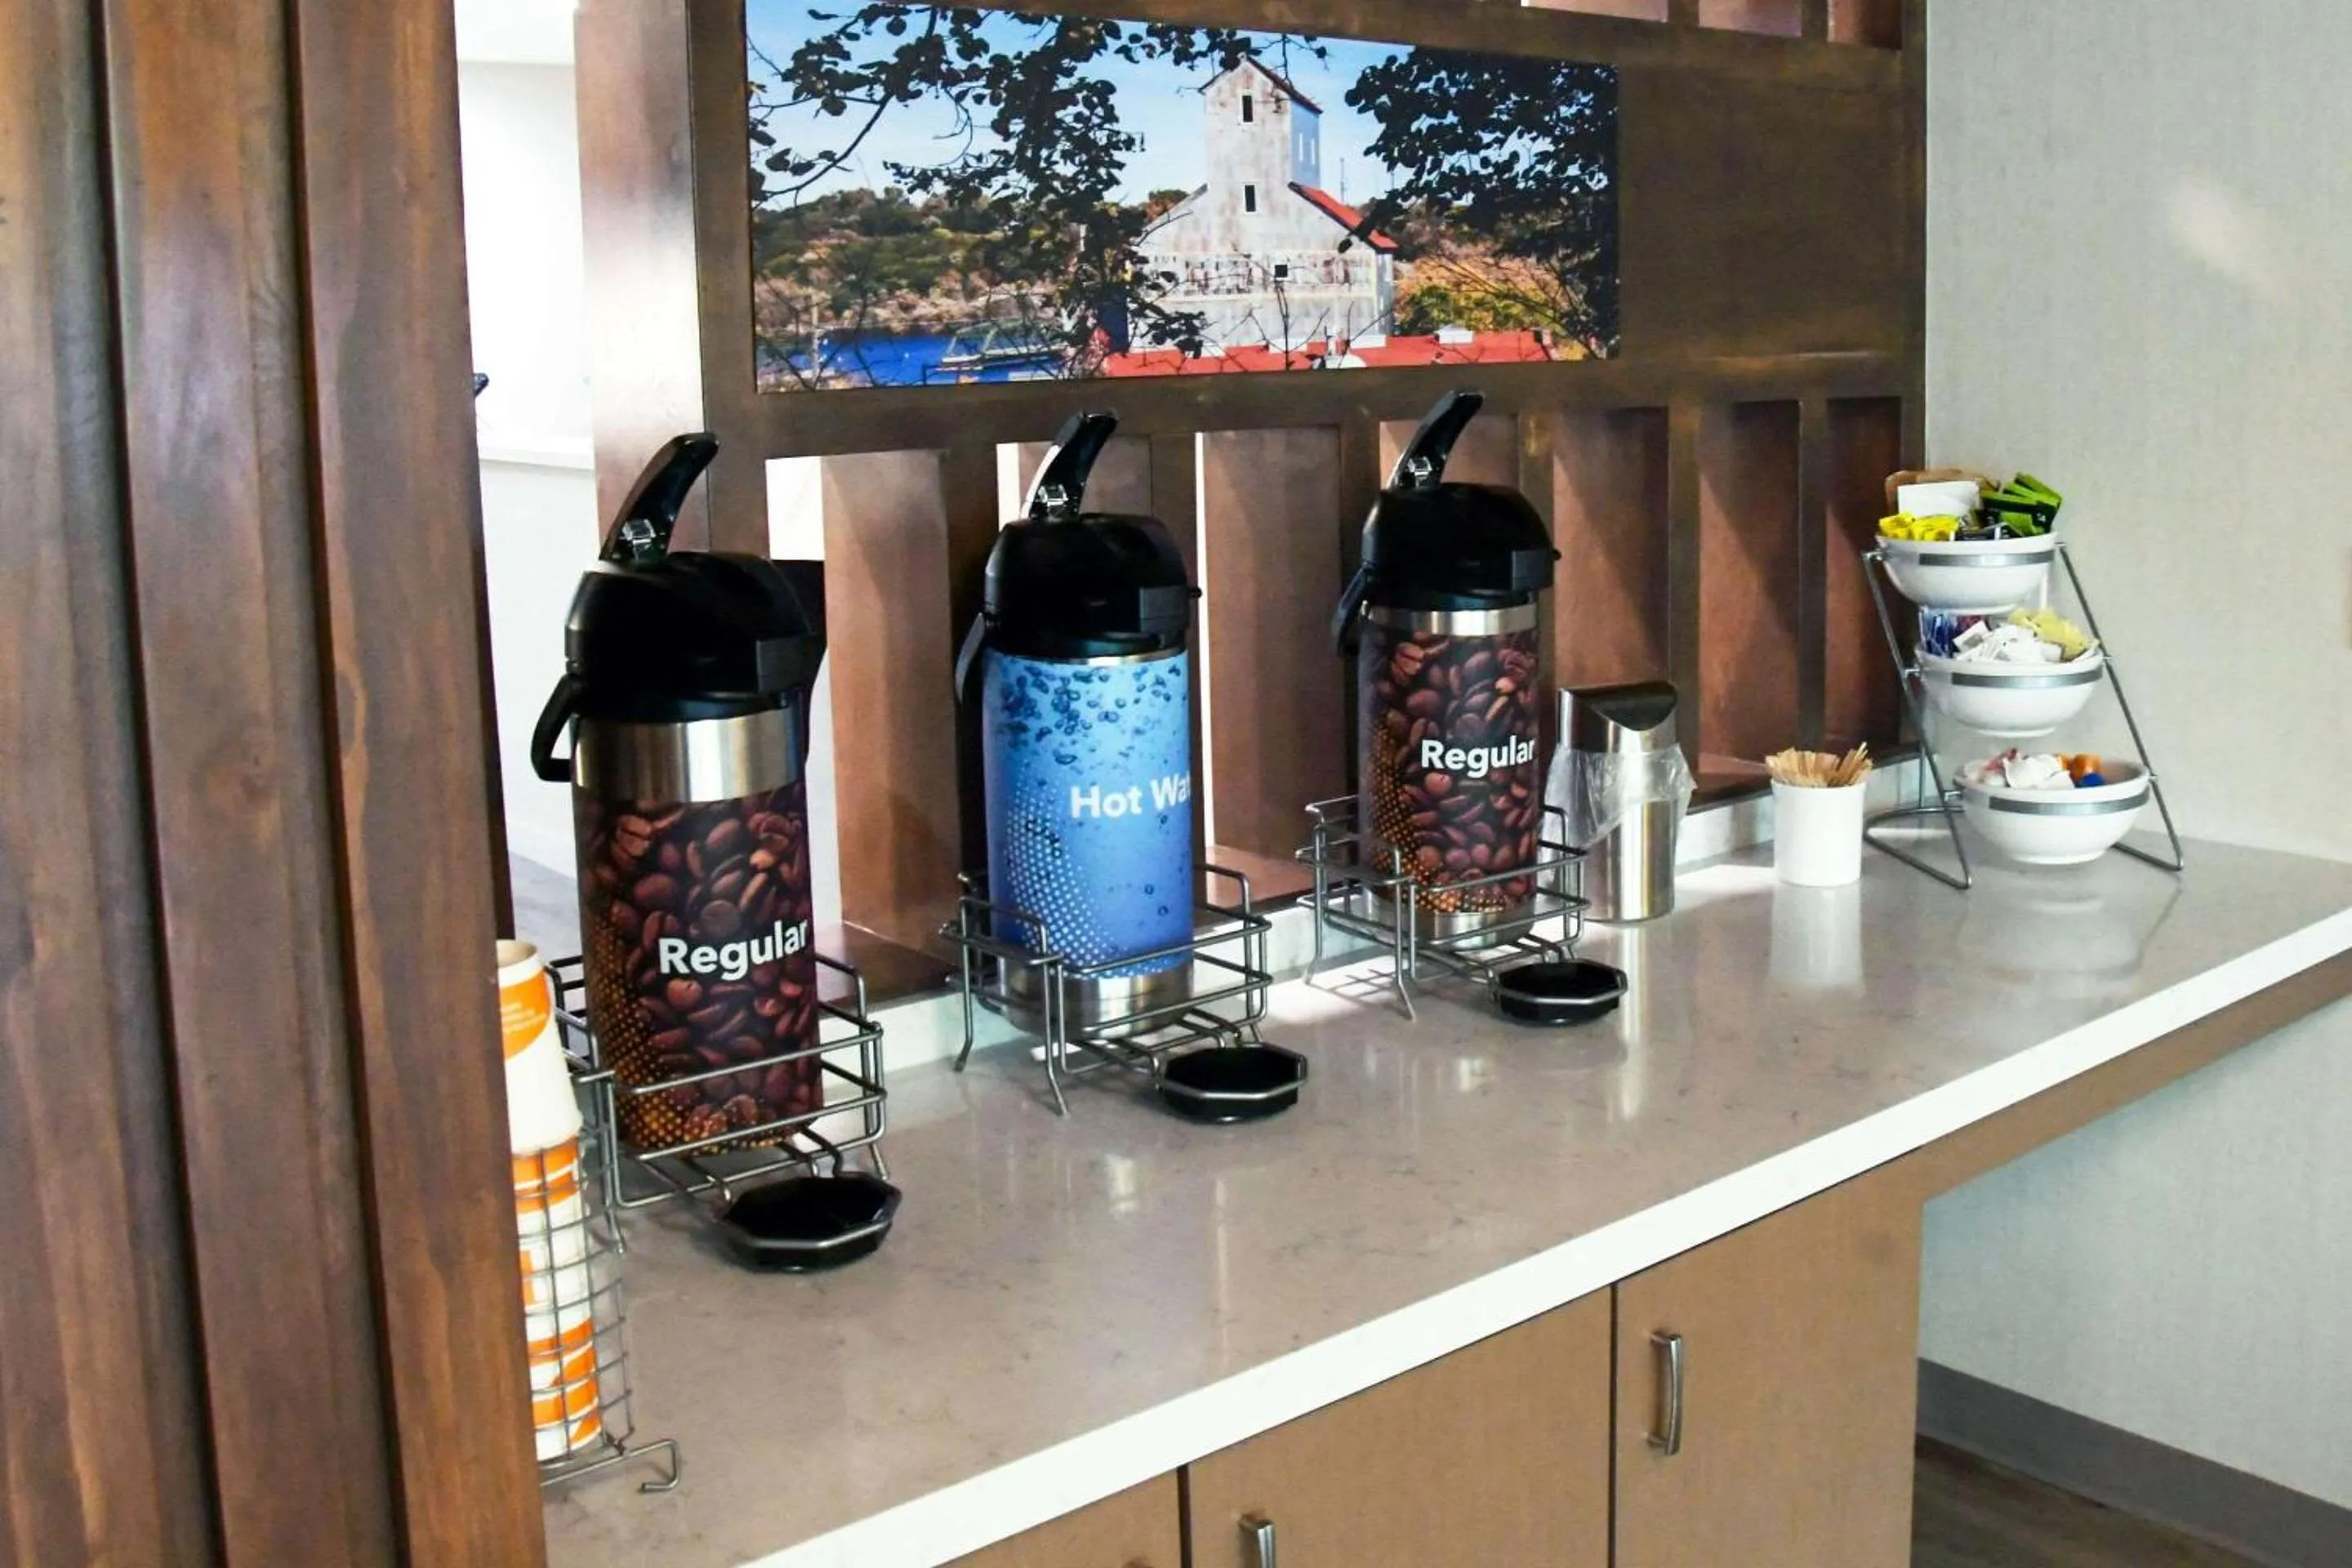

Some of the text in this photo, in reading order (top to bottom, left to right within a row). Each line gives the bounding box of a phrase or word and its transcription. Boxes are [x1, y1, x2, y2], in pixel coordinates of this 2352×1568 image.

[1421, 735, 1535, 778] Regular
[1070, 785, 1143, 818] Hot
[658, 920, 808, 981] Regular
